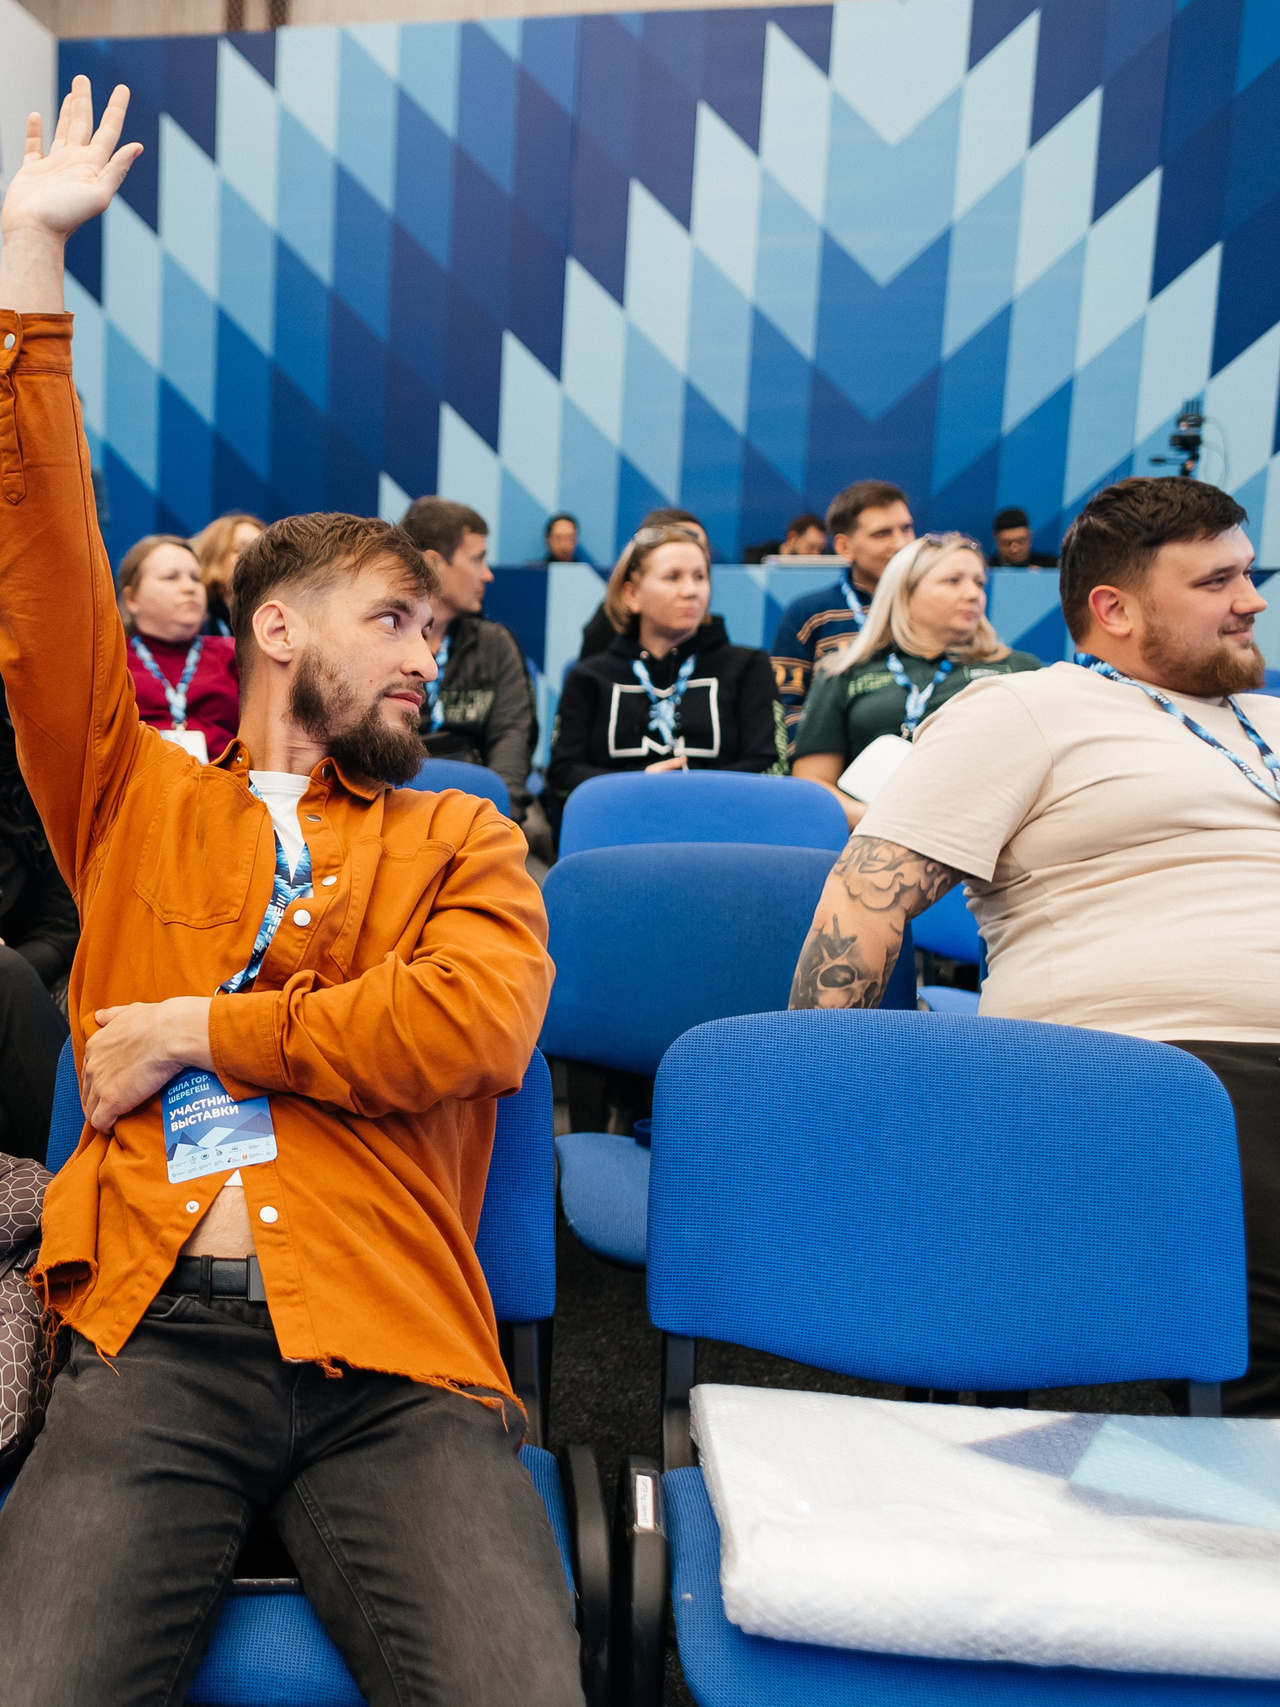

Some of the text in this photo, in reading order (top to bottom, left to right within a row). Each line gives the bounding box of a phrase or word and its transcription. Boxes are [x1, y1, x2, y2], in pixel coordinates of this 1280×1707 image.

[167, 1081, 190, 1096] СИЛА
[168, 1083, 210, 1104] ШЕРЕГЕШ
[170, 1105, 239, 1132] ВЫСТАВКИ
